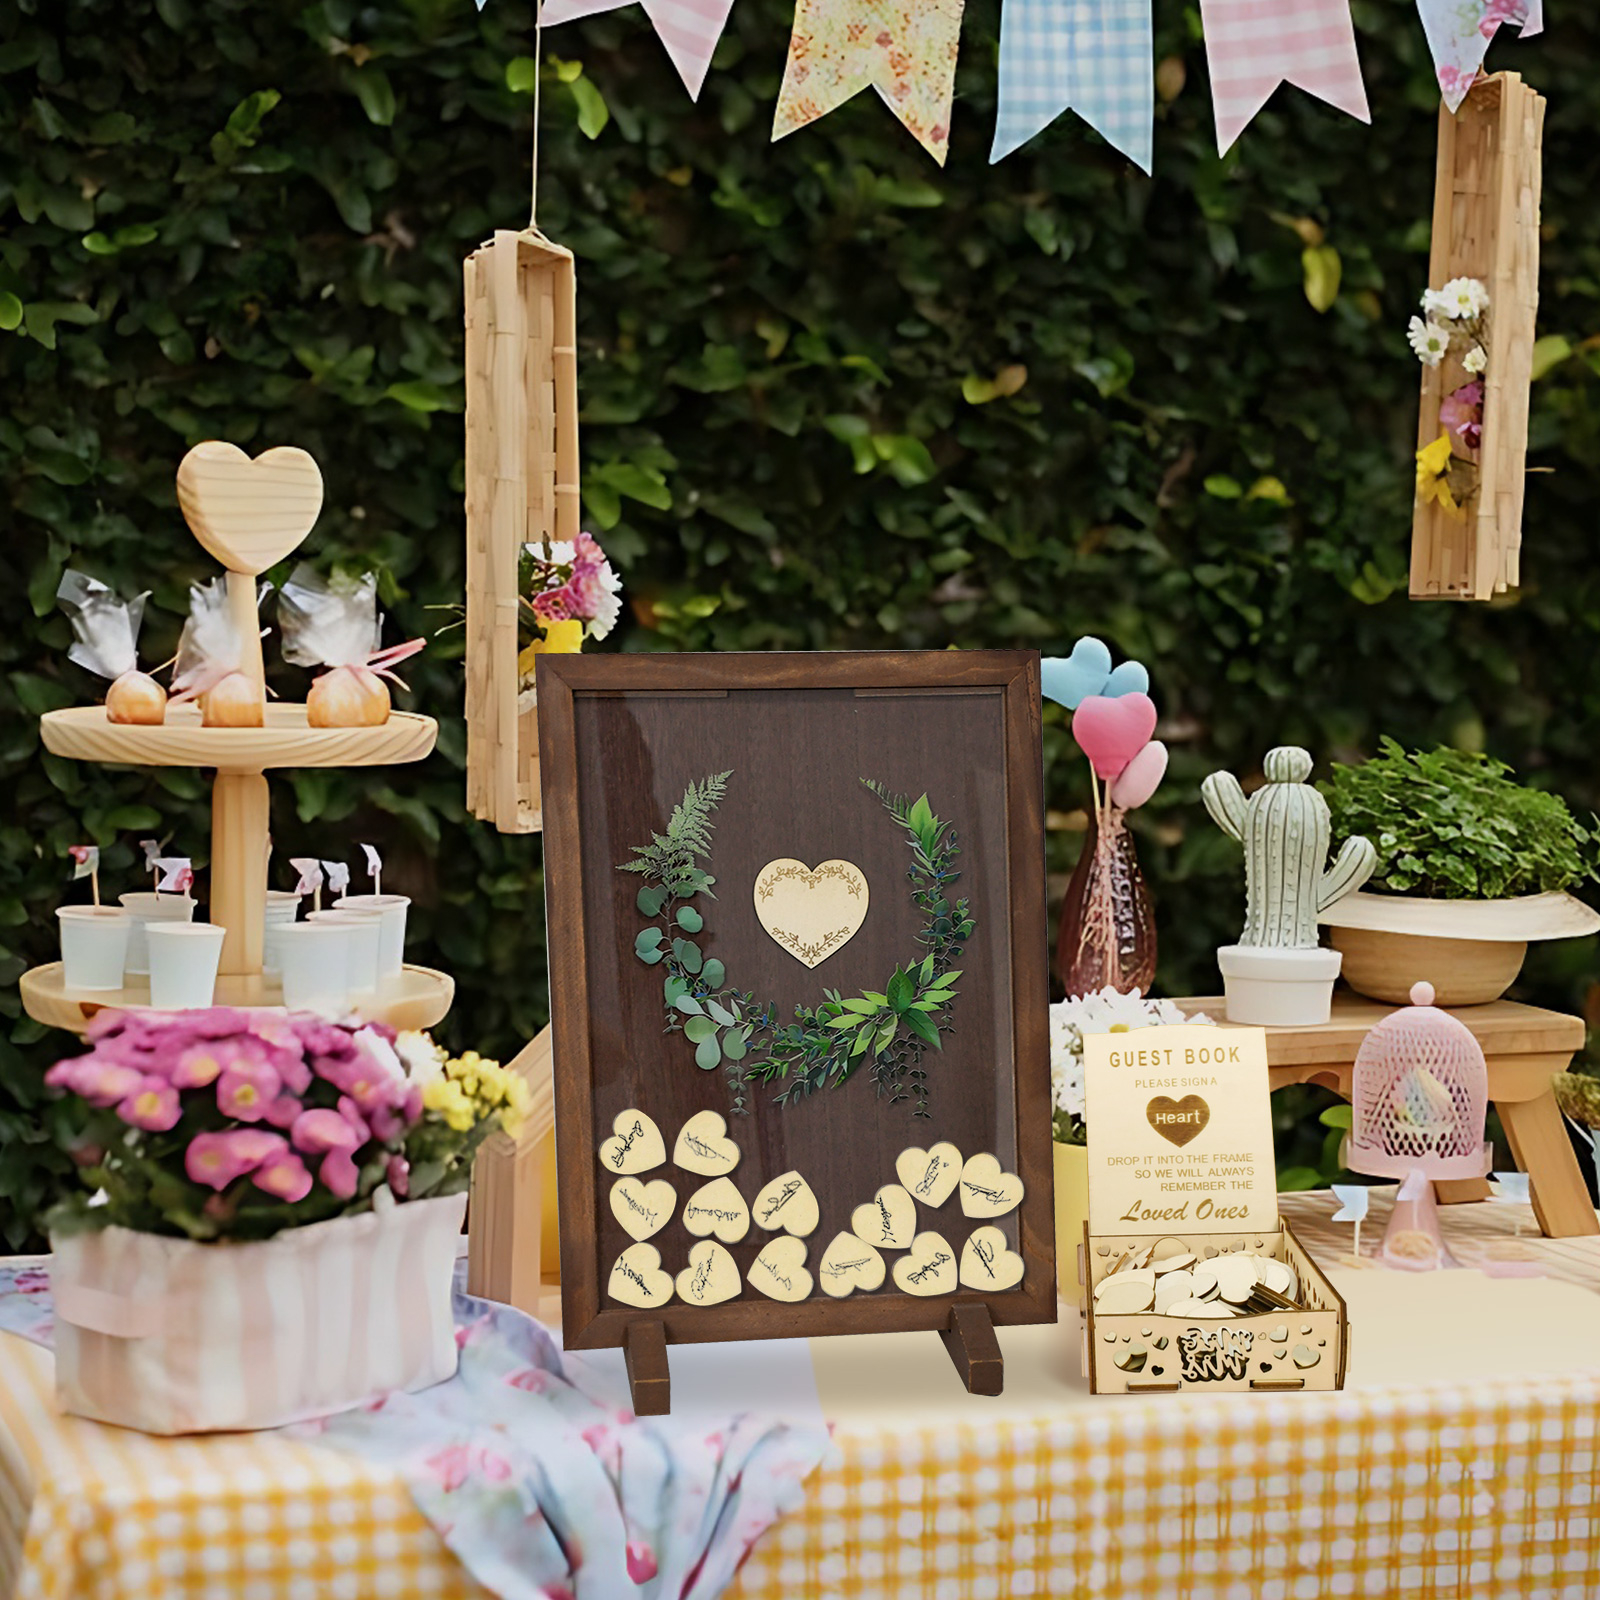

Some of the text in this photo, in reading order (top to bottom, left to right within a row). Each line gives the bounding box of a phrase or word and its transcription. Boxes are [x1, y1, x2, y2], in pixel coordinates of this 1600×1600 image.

[1109, 1046, 1241, 1068] GUEST BOOK
[1135, 1077, 1218, 1088] PLEASE SIGN A
[1155, 1109, 1201, 1124] Heart
[1107, 1153, 1253, 1166] DROP IT INTO THE FRAME
[1135, 1167, 1254, 1179] SO WE WILL ALWAYS
[1160, 1180, 1253, 1192] REMEMBER THE
[1119, 1198, 1250, 1222] Loved Ones
